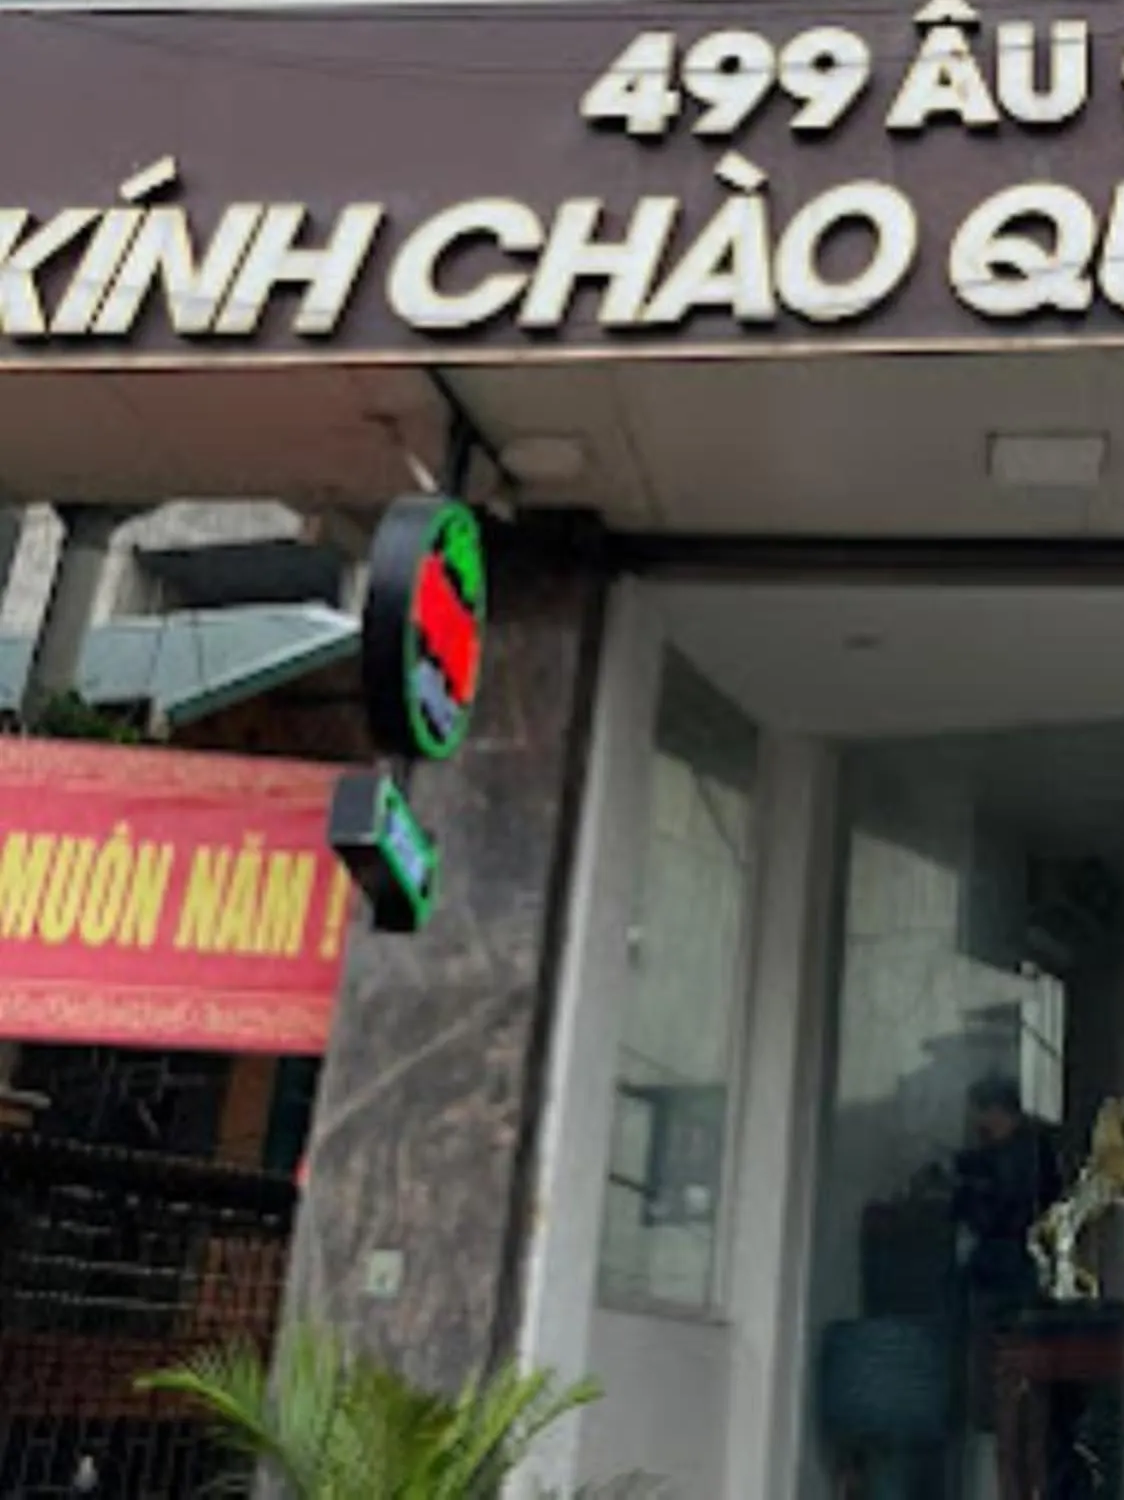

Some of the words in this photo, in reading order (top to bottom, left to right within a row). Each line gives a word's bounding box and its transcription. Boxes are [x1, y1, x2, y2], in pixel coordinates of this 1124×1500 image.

[580, 27, 872, 136] 499
[0, 155, 385, 334] KÍNH
[386, 151, 918, 330] CHÀO
[0, 820, 174, 953] MUÔN
[174, 830, 317, 958] NĂM
